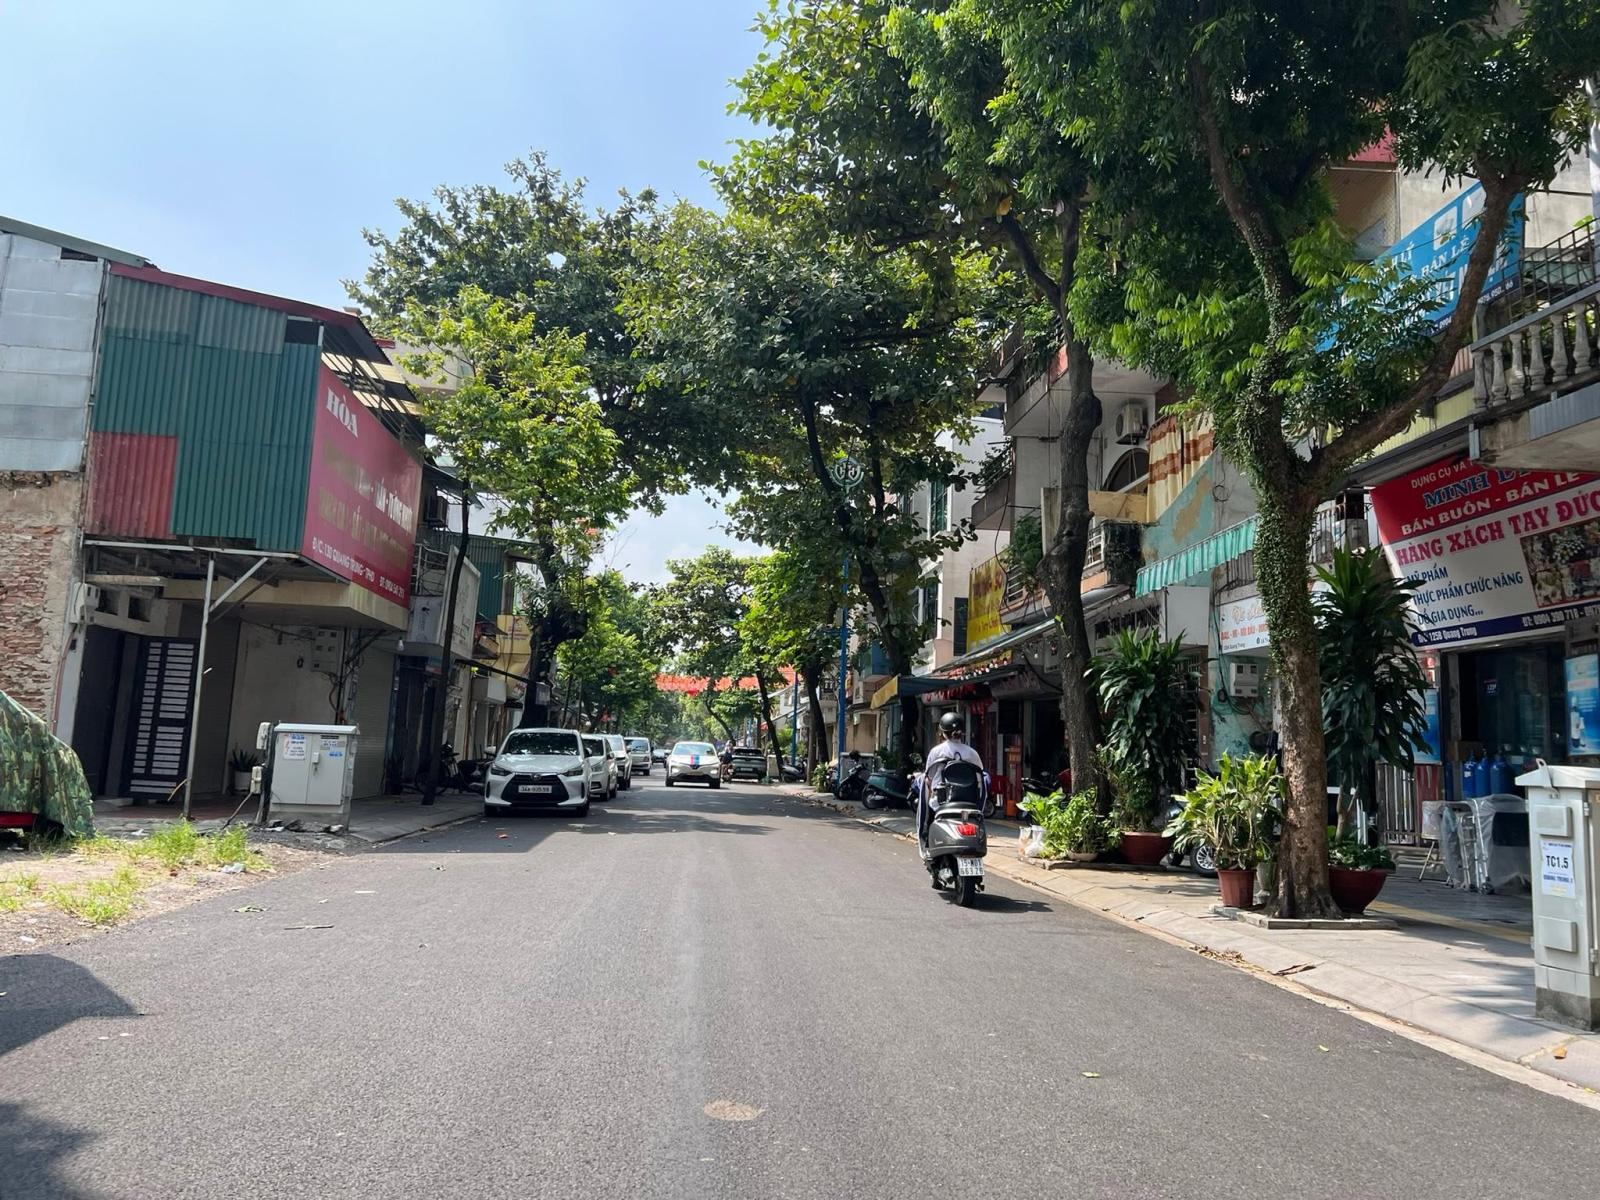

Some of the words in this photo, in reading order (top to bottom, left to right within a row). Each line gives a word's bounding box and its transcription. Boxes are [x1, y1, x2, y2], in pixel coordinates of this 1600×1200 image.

[326, 387, 358, 438] HÒA
[1402, 516, 1434, 536] BÁN
[1439, 499, 1491, 529] BUÔN
[1505, 478, 1550, 502] BÁN
[1424, 472, 1491, 510] MINH
[1396, 537, 1444, 566] HÀNG
[1446, 525, 1505, 549] XÁCH
[1507, 505, 1550, 535] TAY
[1412, 589, 1436, 607] THỰC
[1436, 581, 1464, 601] PHẨM
[1464, 576, 1492, 597] CHỨC
[1493, 570, 1524, 591] NĂNG
[1431, 610, 1447, 623] GIA
[1460, 627, 1478, 637] Trung
[1546, 855, 1569, 869] TC1.5
